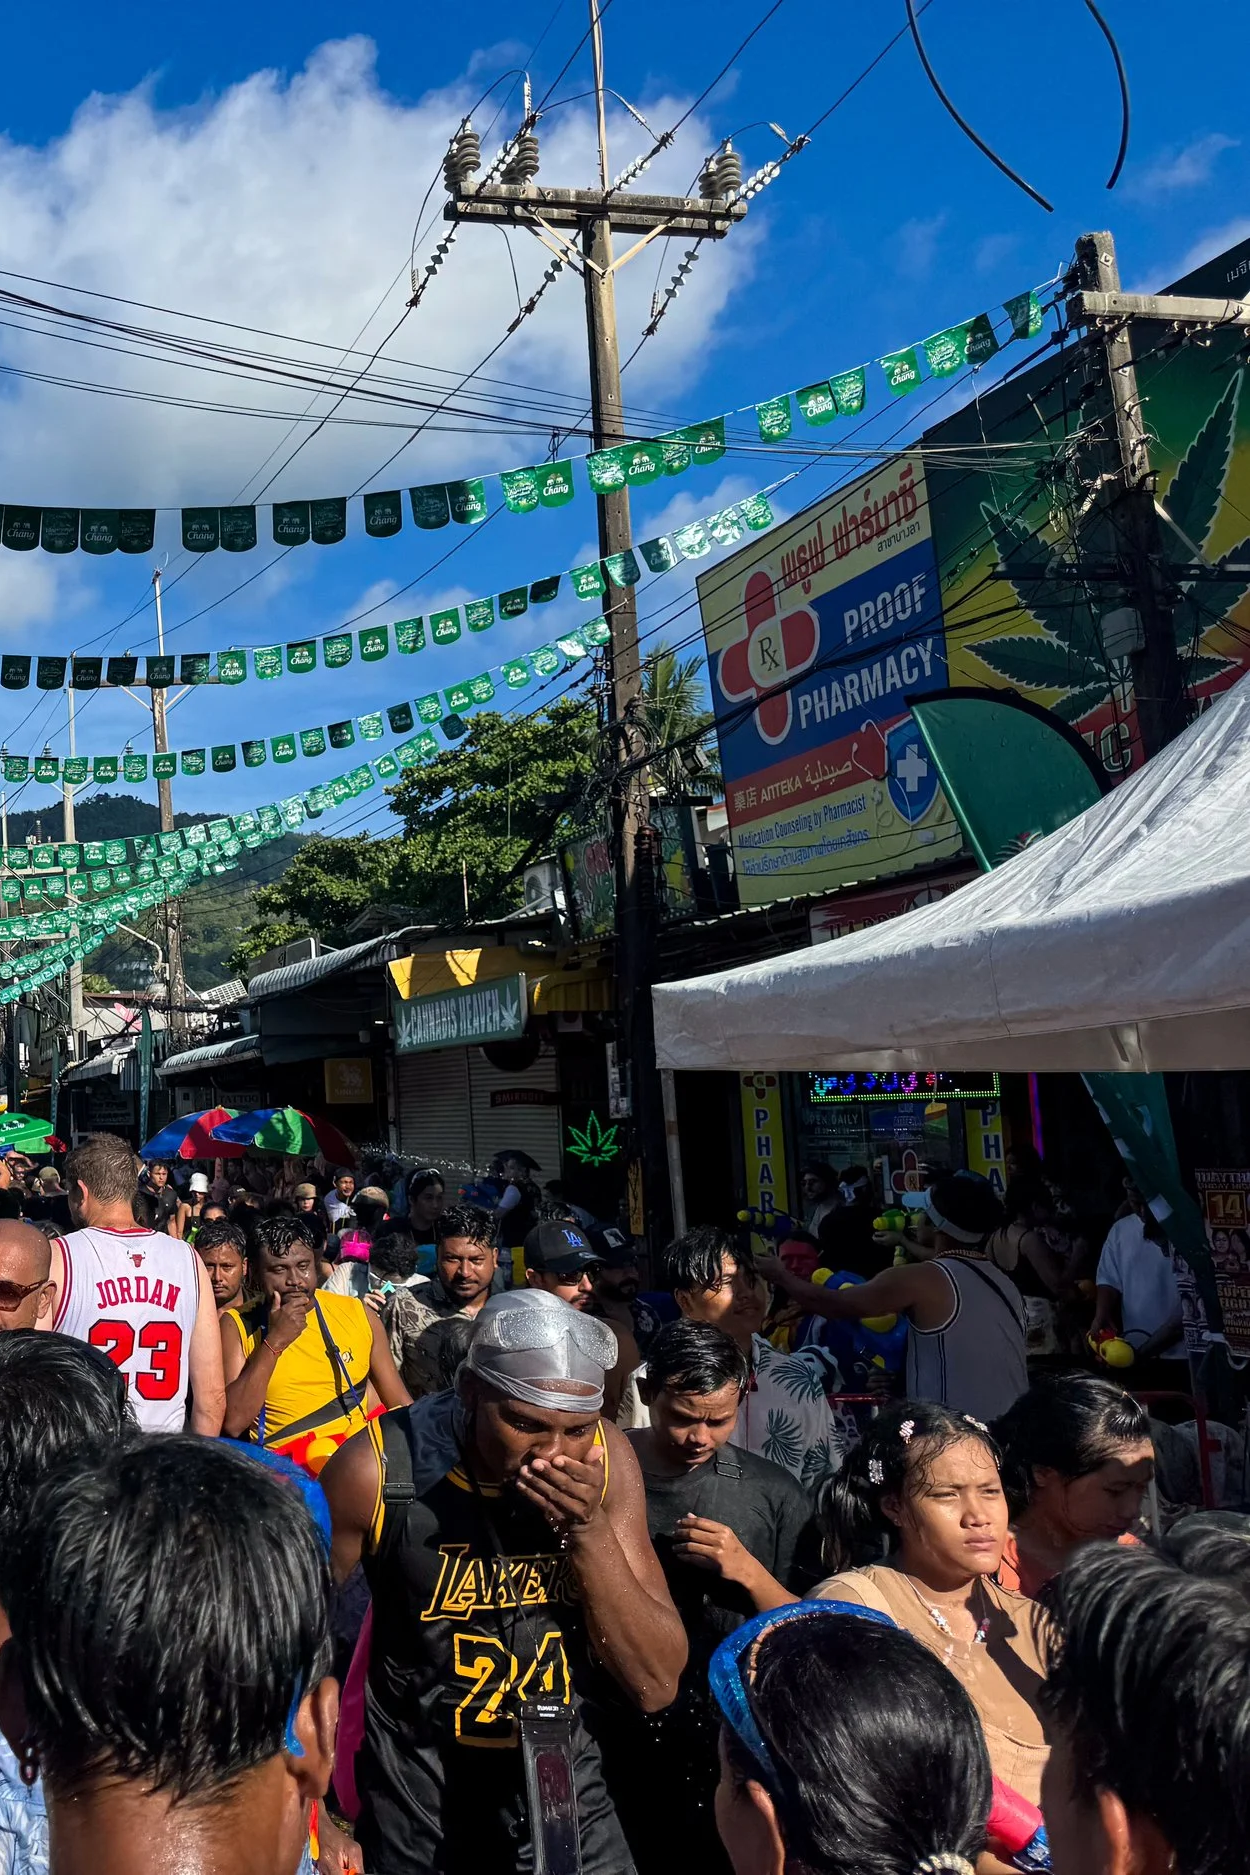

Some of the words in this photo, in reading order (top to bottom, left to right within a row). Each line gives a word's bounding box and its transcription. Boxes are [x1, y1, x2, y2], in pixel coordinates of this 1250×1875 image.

[964, 337, 991, 355] Chang
[890, 369, 916, 387] Chang
[807, 400, 833, 418] Chang
[694, 440, 721, 455] Chang
[628, 461, 656, 476] Chang
[543, 483, 569, 497] Chang
[455, 500, 481, 513] Chang
[370, 514, 397, 526] Chang
[6, 528, 35, 541] Chang
[187, 529, 215, 542] Chang
[277, 523, 305, 535] Chang
[85, 531, 113, 544] Chang
[843, 573, 927, 645] PROOF
[363, 643, 385, 654] Chang
[290, 654, 313, 665] Chang
[4, 671, 27, 682] Chang
[75, 672, 98, 683] Chang
[149, 671, 171, 681] Chang
[221, 667, 243, 677] Chang
[798, 637, 934, 730] PHARMACY
[738, 827, 774, 850] Medication
[774, 814, 813, 839] Counseling
[814, 810, 823, 826] by
[823, 793, 867, 821] Pharmacist
[410, 998, 458, 1046] CANNABIS
[458, 988, 501, 1037] HEAVEN
[754, 1108, 775, 1214] PHAR
[1210, 1194, 1243, 1218] 14
[561, 1229, 585, 1248] LA
[96, 1276, 183, 1313] JORDAN
[88, 1319, 183, 1402] 23
[454, 1632, 571, 1748] 24
